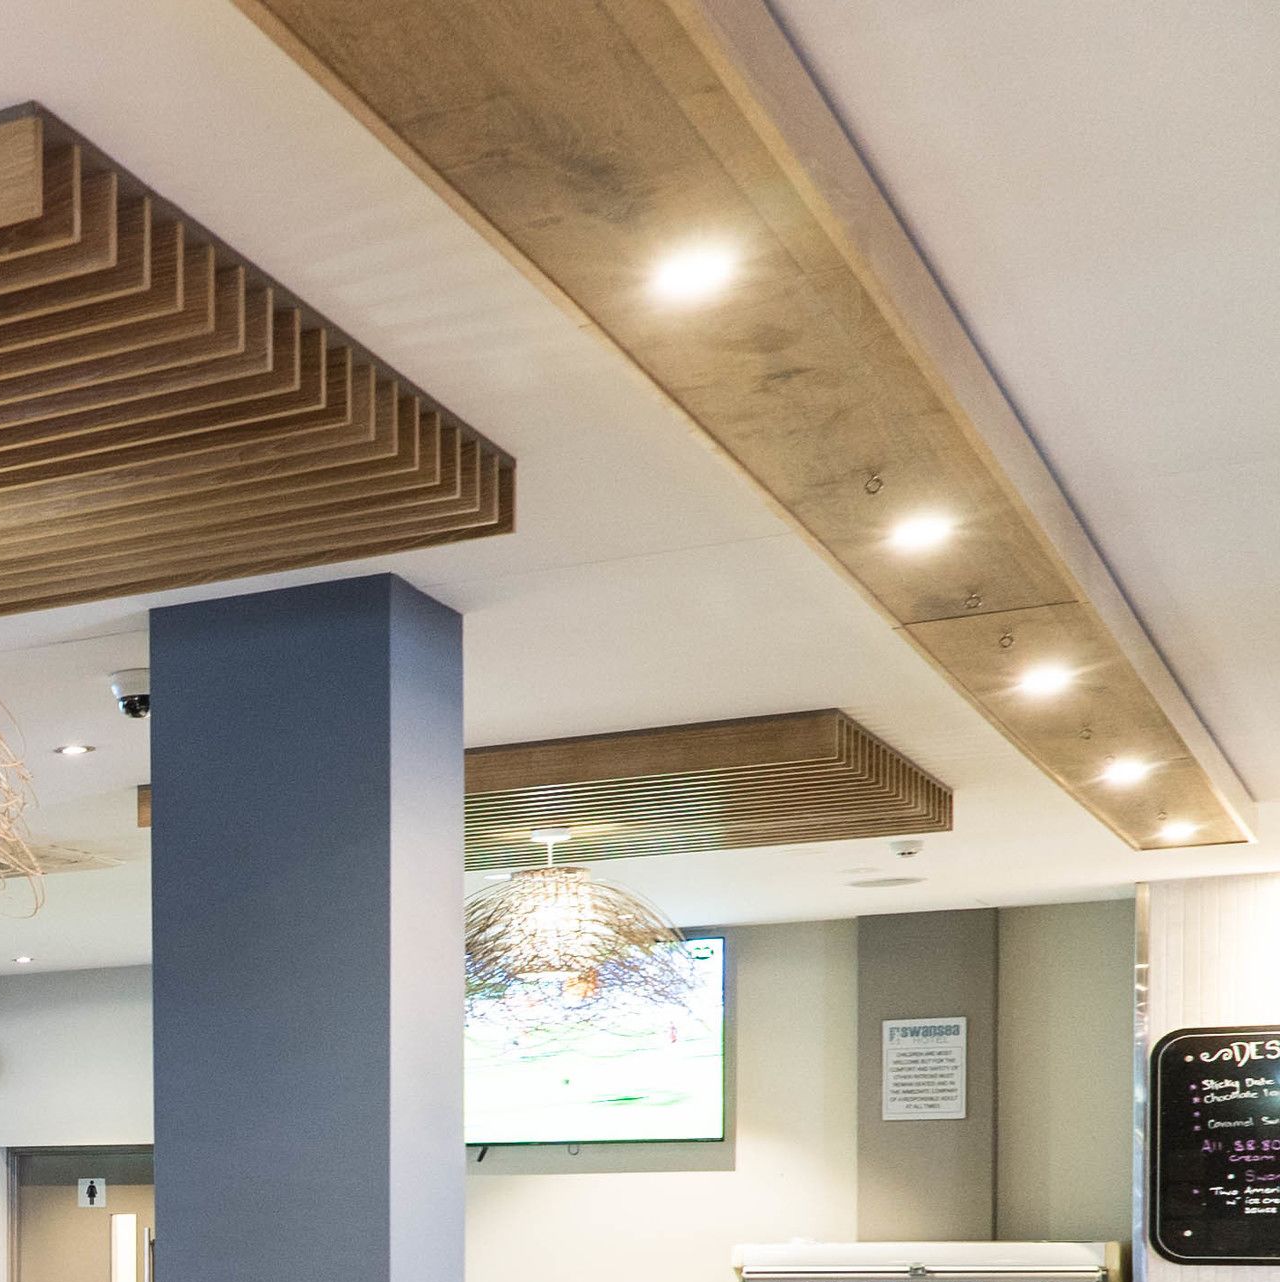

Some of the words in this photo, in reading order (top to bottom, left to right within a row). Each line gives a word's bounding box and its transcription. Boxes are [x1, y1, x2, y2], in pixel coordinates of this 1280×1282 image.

[901, 1024, 960, 1038] swansea
[1202, 1079, 1241, 1094] Sticky
[1245, 1077, 1275, 1088] Date
